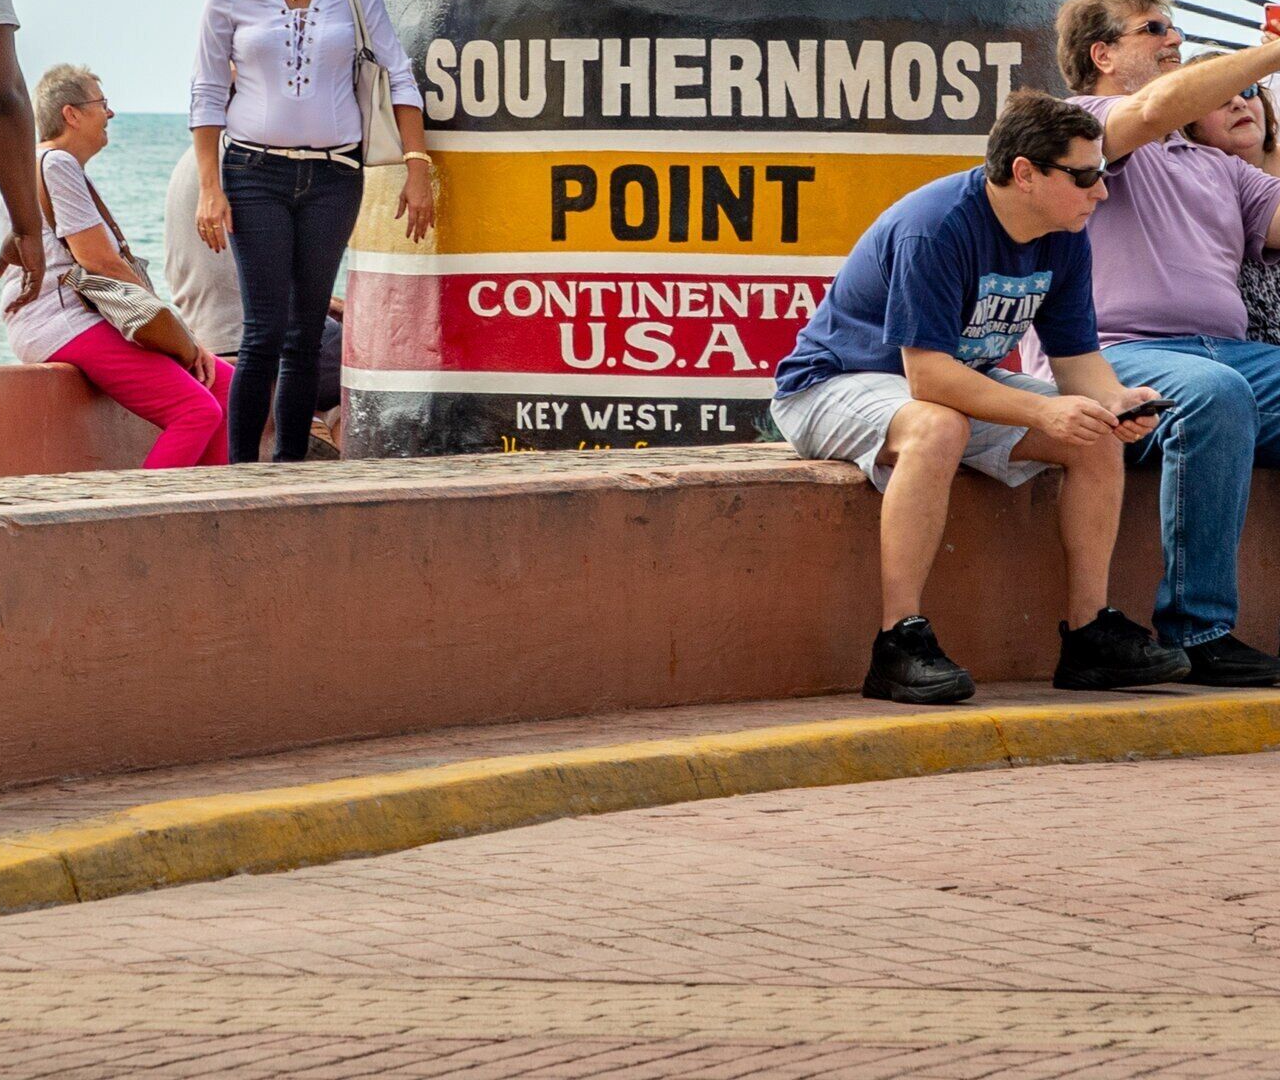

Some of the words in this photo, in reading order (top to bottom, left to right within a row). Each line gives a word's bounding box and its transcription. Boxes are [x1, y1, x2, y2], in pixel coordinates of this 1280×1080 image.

[425, 37, 1022, 121] SOUTHERNMOST
[551, 164, 816, 243] POINT
[468, 279, 832, 320] CONTINENTA
[559, 321, 770, 371] U.S.A.
[516, 401, 569, 430] KEY
[580, 403, 682, 433] WEST,
[699, 404, 736, 431] FL
